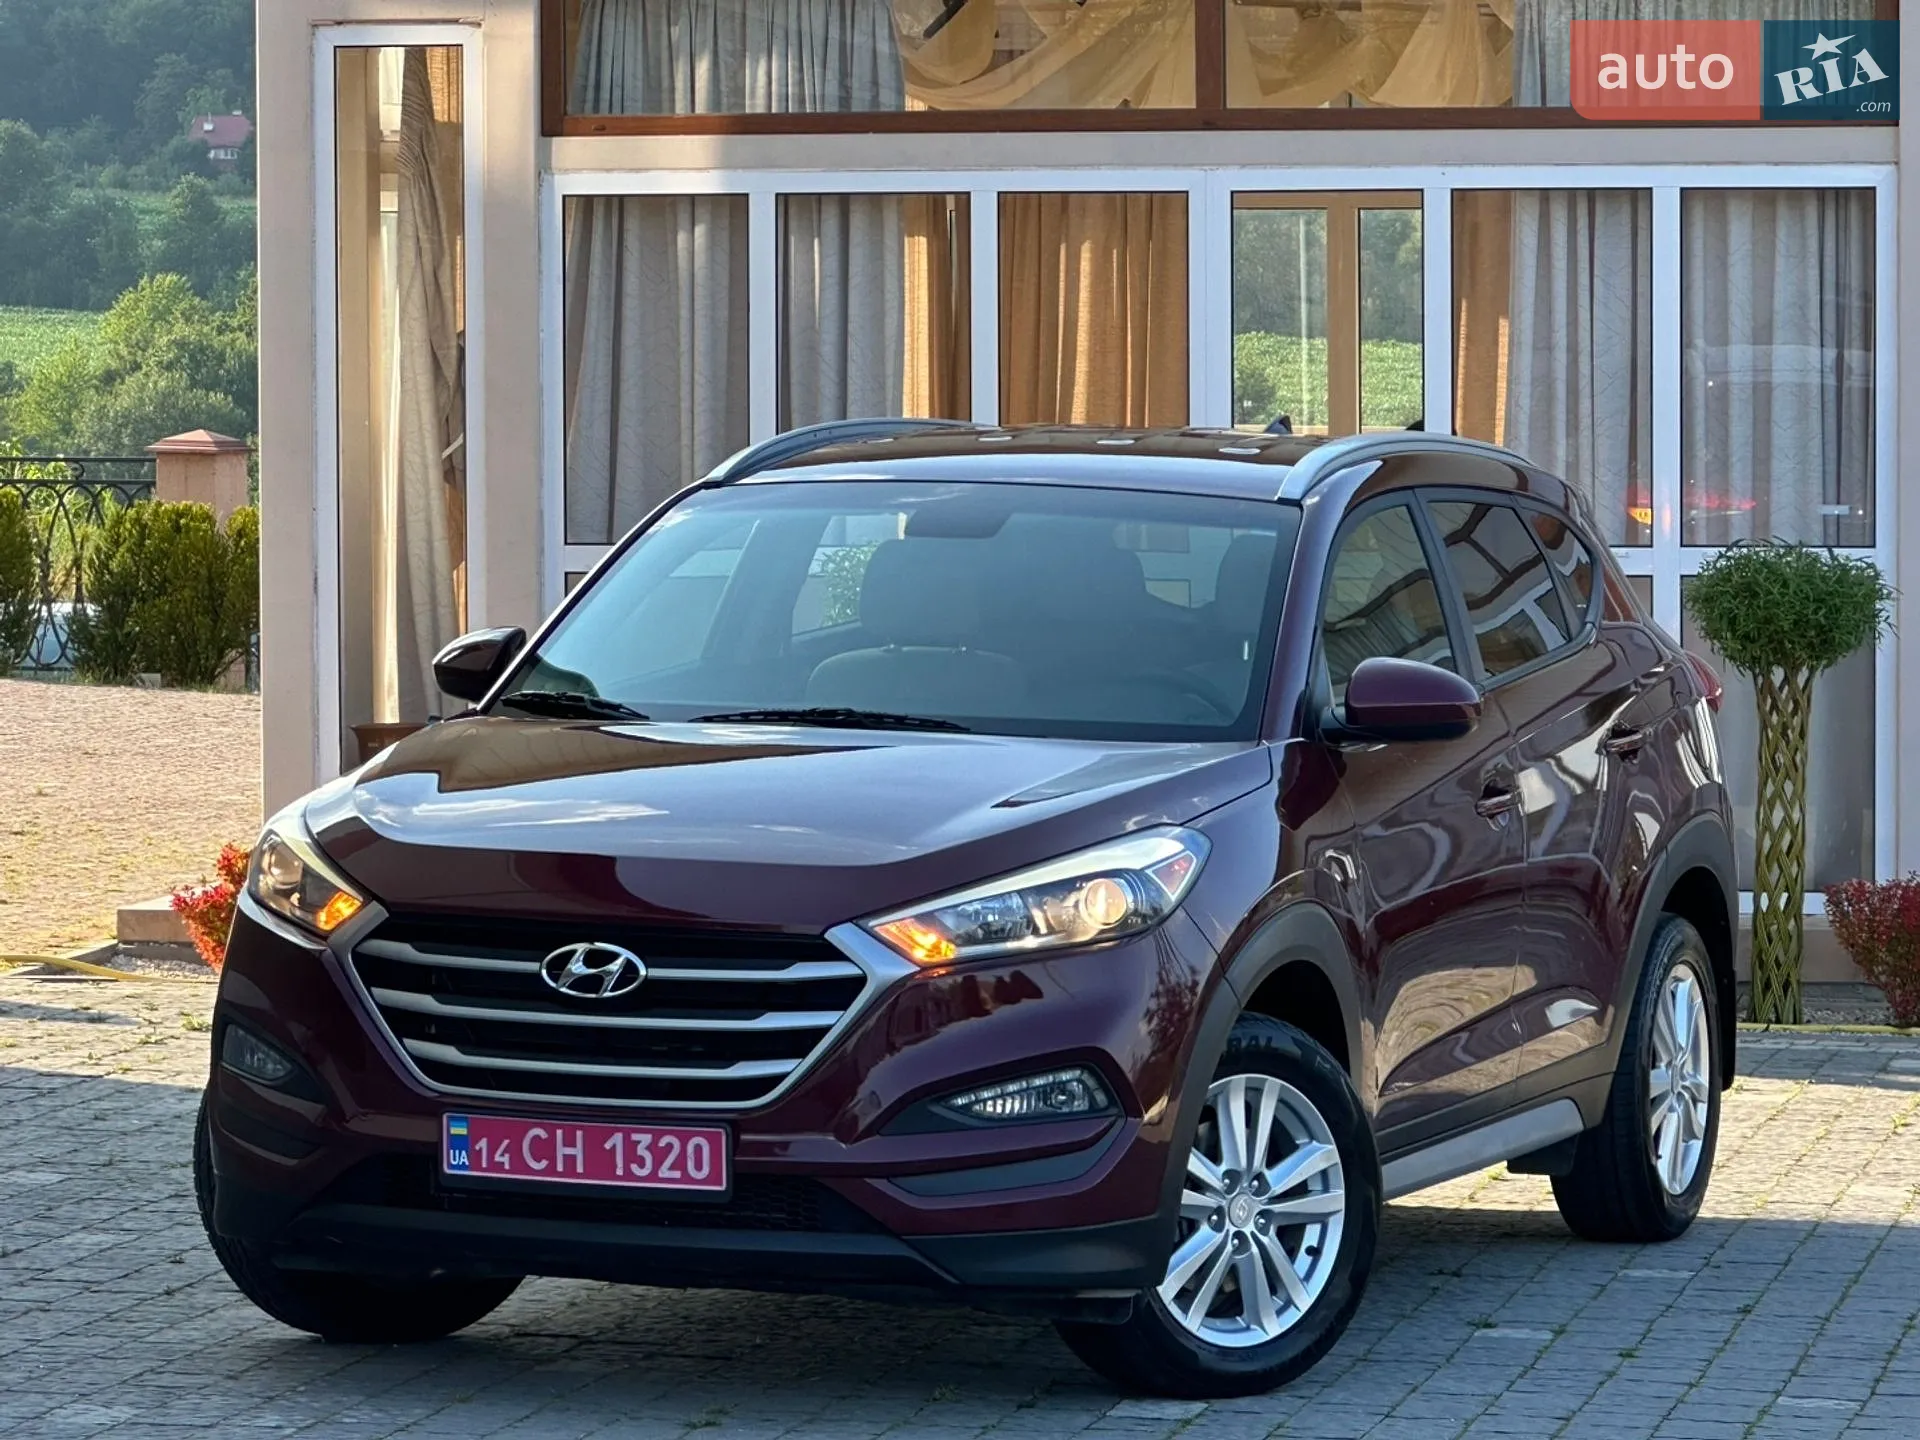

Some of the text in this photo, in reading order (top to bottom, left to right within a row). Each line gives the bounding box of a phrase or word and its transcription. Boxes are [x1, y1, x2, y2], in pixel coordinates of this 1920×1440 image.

[450, 1149, 469, 1166] UA
[475, 1127, 710, 1180] 14 CH 1320
